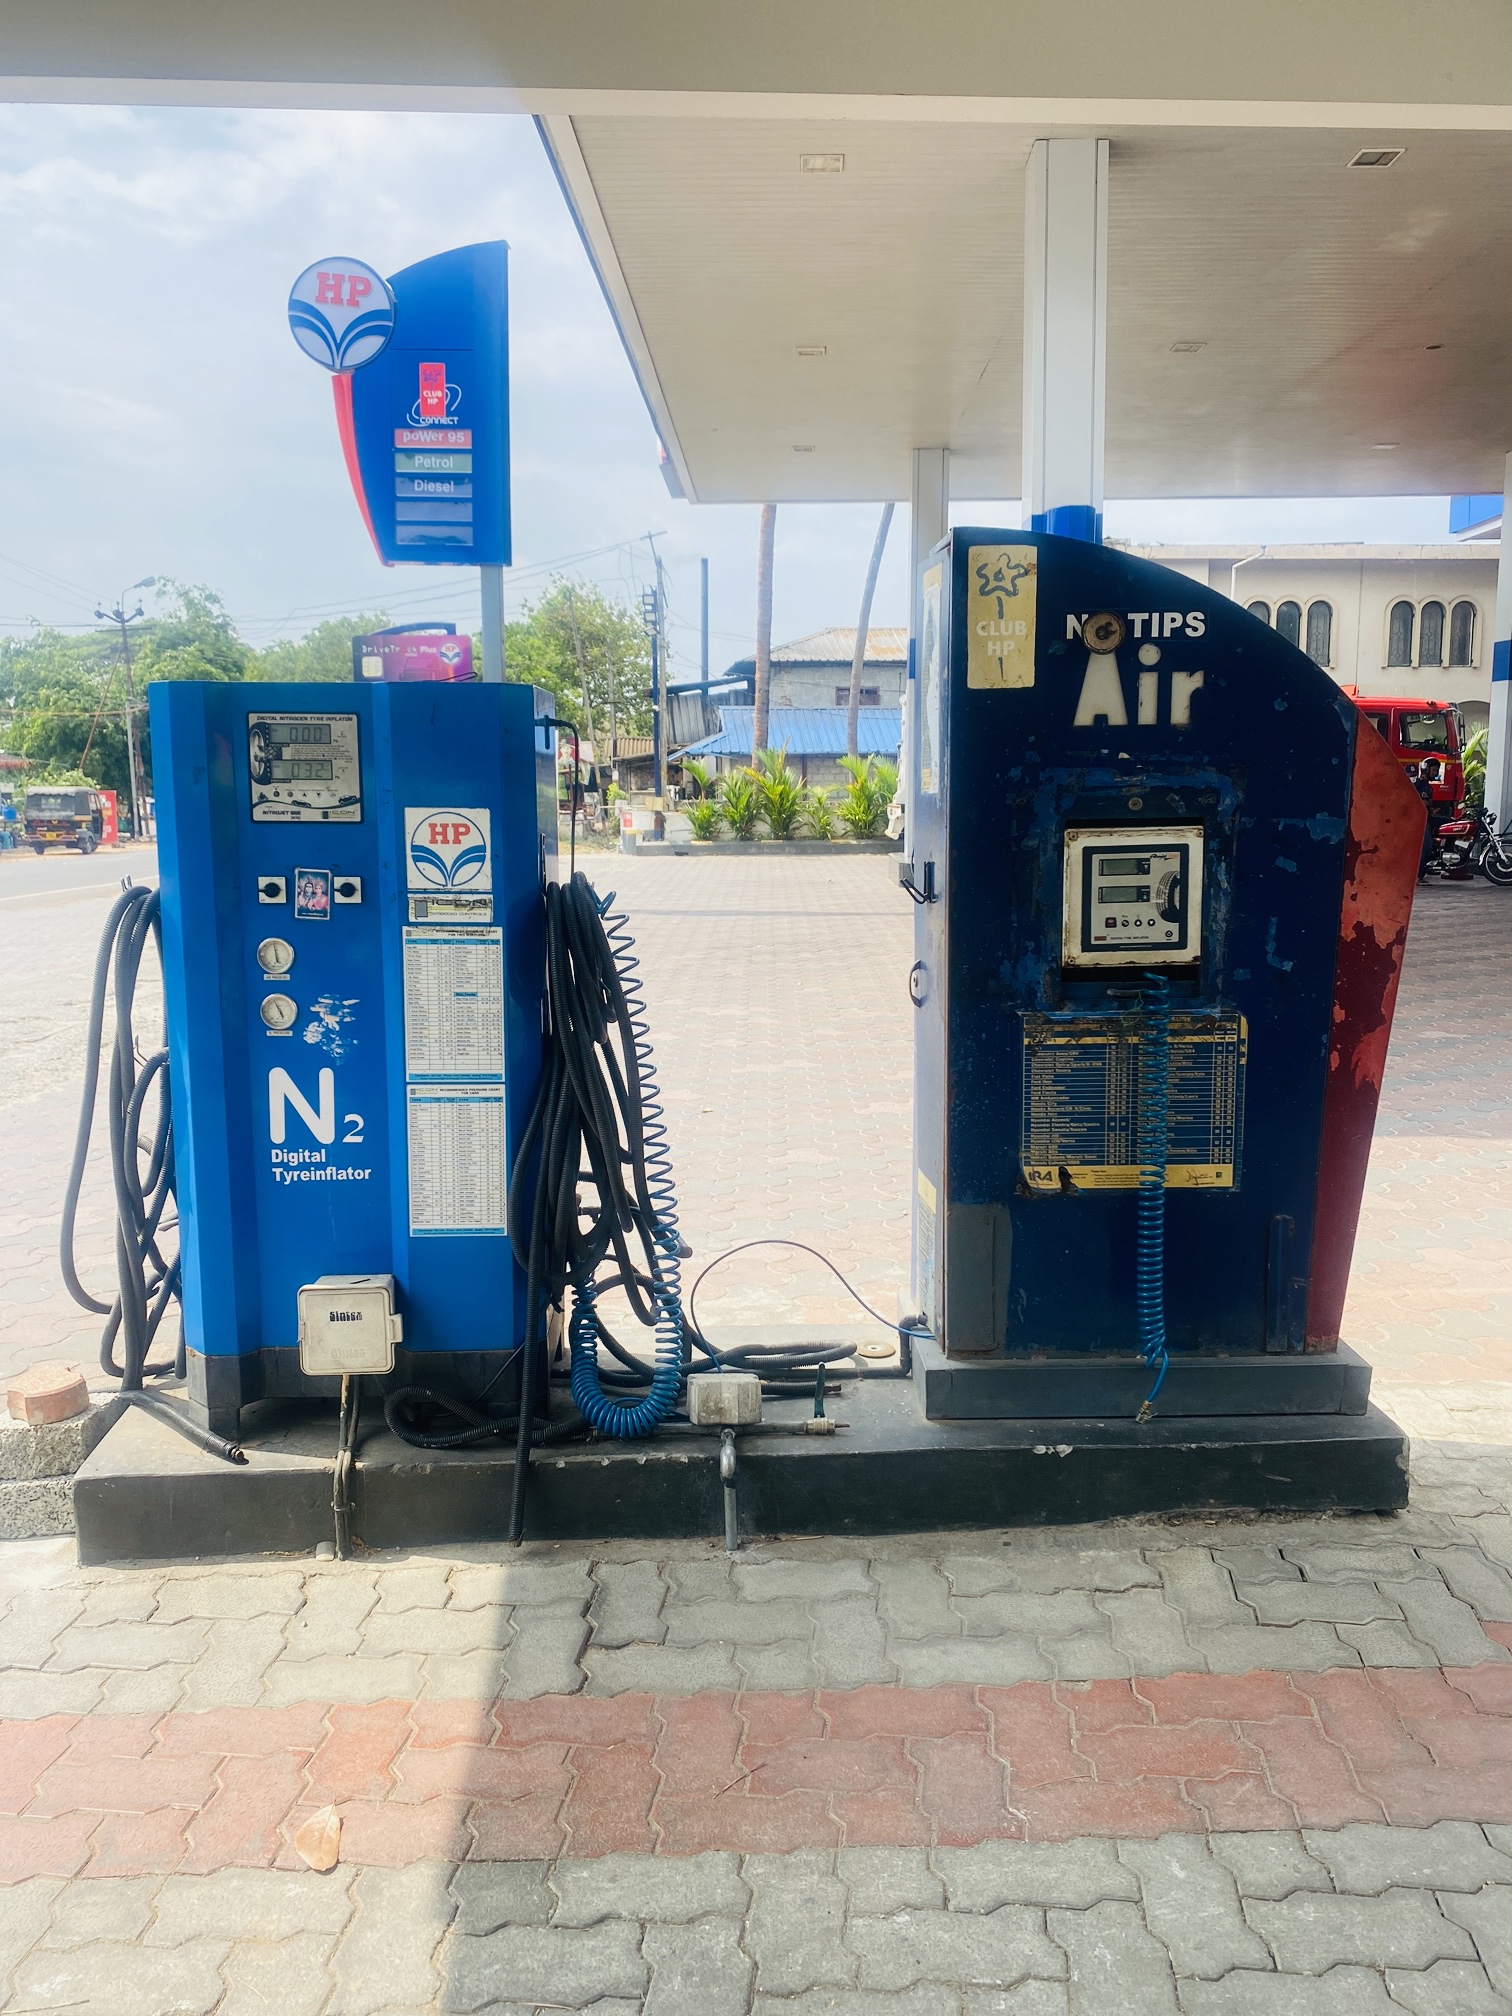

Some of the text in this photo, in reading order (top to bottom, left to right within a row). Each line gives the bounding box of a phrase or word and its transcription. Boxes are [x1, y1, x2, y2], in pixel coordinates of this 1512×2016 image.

[315, 272, 372, 307] HP
[448, 432, 464, 442] 95
[415, 456, 453, 468] Petrol
[414, 480, 454, 492] Diesel
[976, 621, 1027, 636] CLUB
[1128, 612, 1205, 638] TIPS
[988, 641, 1015, 655] HP
[1073, 643, 1204, 726] Air
[292, 763, 324, 777] 032
[428, 823, 470, 844] HP
[271, 1149, 325, 1166] Digital
[272, 1167, 371, 1184] Tyreinflator
